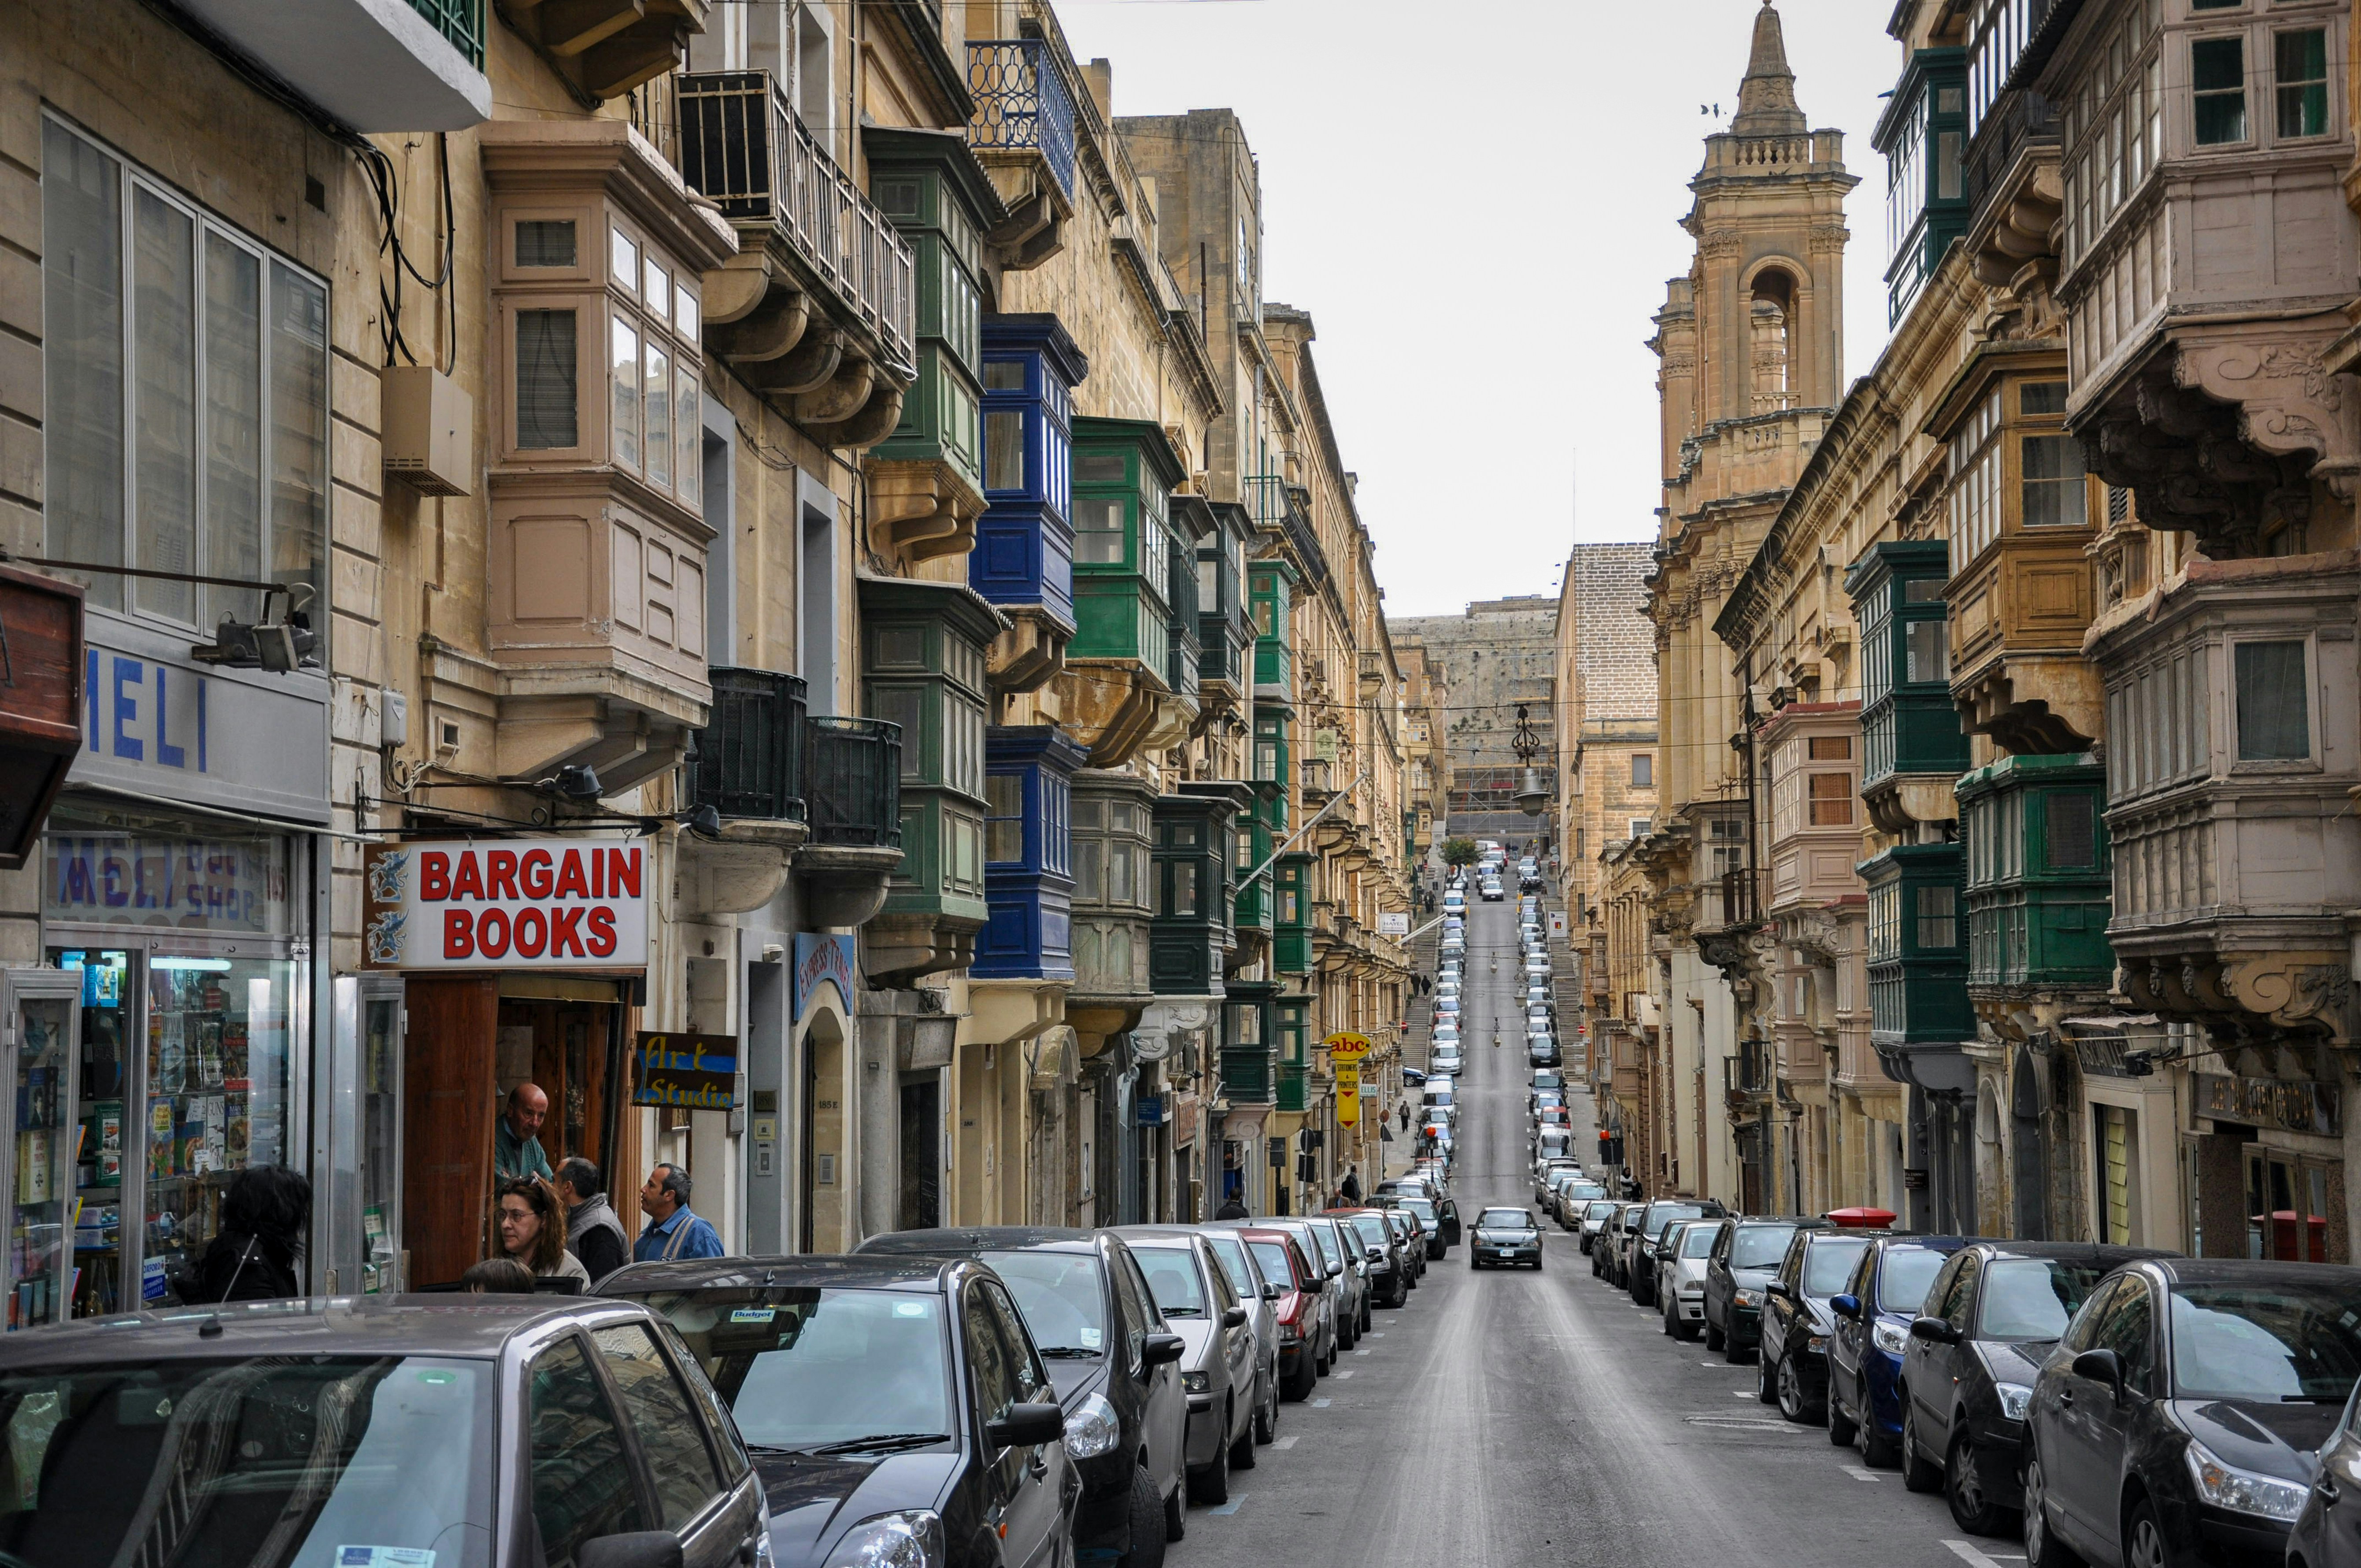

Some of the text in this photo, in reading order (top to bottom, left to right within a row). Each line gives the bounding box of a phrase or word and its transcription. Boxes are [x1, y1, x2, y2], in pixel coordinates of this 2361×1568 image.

[420, 848, 641, 901] BARGAIN
[186, 884, 254, 922] SHOP
[444, 906, 617, 959] BOOKS
[799, 938, 849, 1002] EXPRESS TRAVEL
[646, 1036, 707, 1070] Art
[1329, 1037, 1366, 1052] abc
[208, 1102, 224, 1116] GUNS
[650, 1079, 731, 1107] Studio
